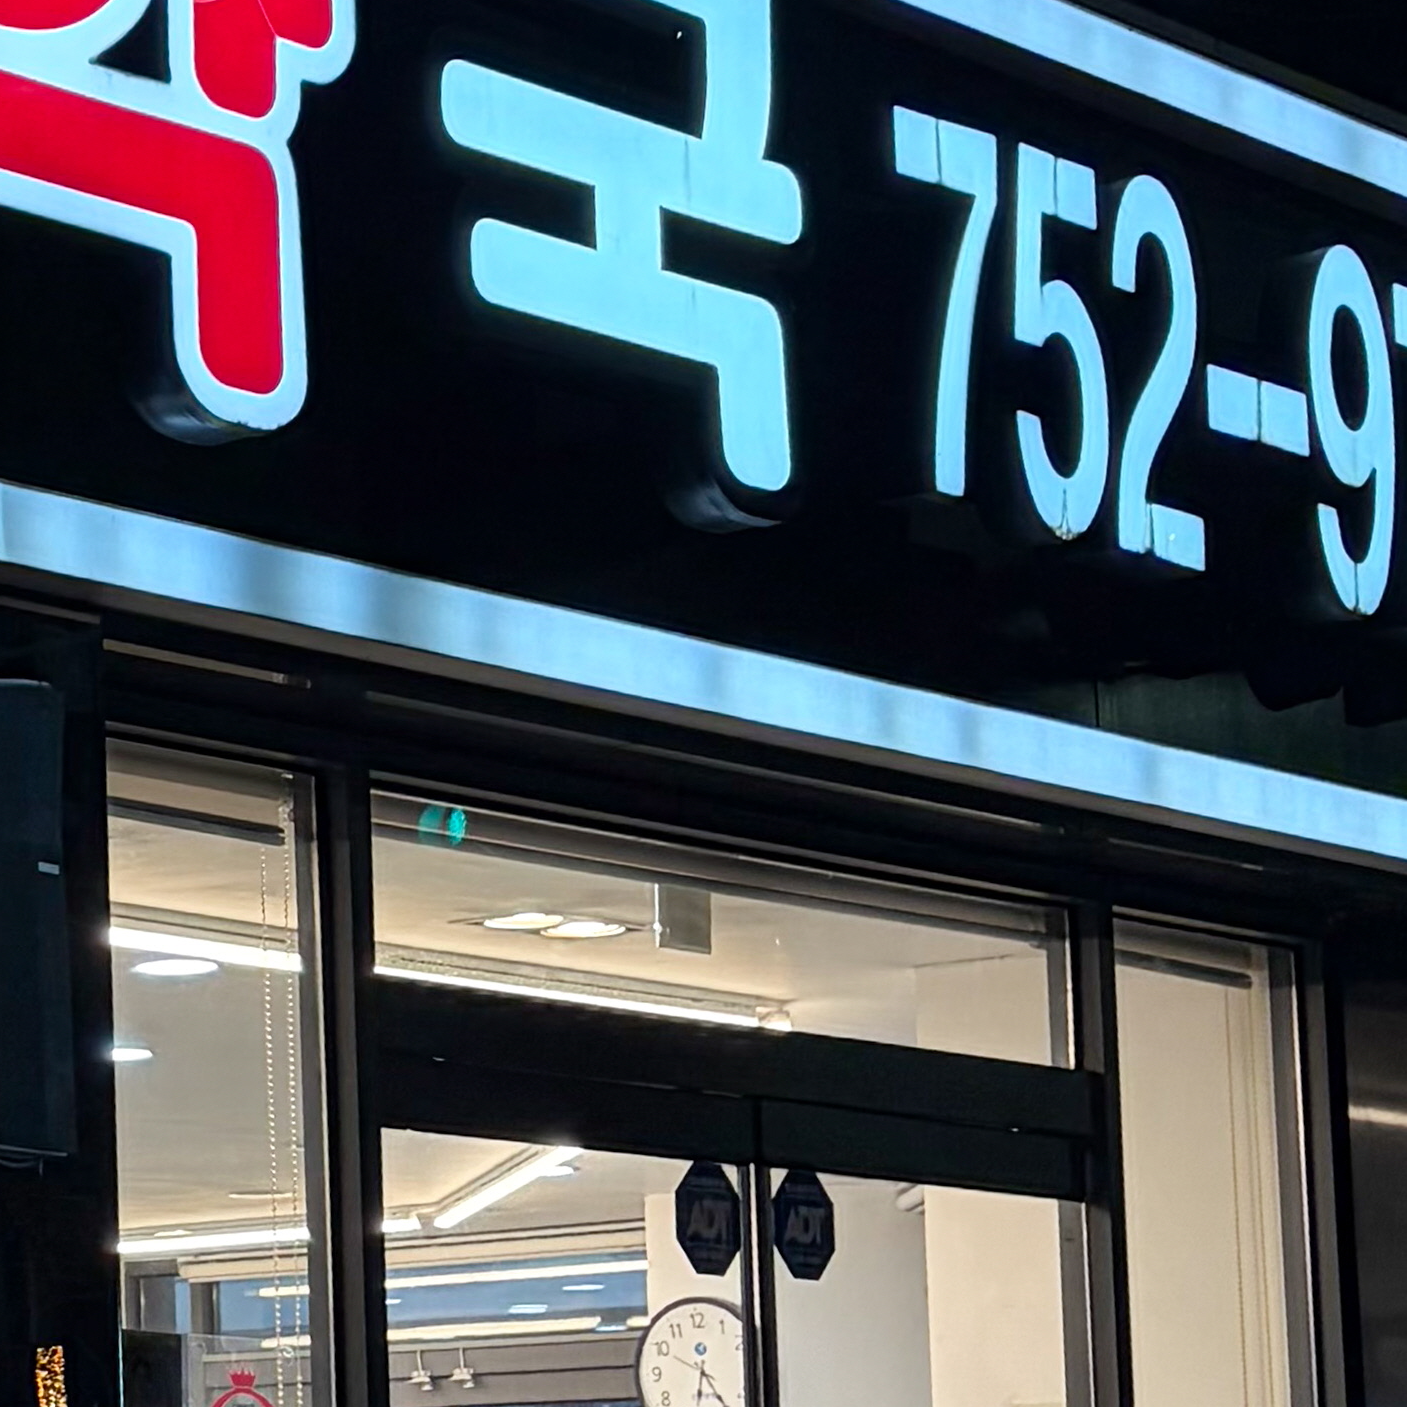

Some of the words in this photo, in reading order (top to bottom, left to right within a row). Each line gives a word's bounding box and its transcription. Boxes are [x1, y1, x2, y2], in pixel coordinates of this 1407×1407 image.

[892, 105, 1407, 615] 752-9
[688, 1200, 730, 1234] ADT
[787, 1204, 824, 1239] ADT
[690, 1312, 706, 1329] 12
[718, 1319, 726, 1335] 1
[669, 1323, 683, 1339] 11
[653, 1341, 670, 1358] 10
[651, 1367, 663, 1383] 9
[660, 1391, 671, 1407] 8
